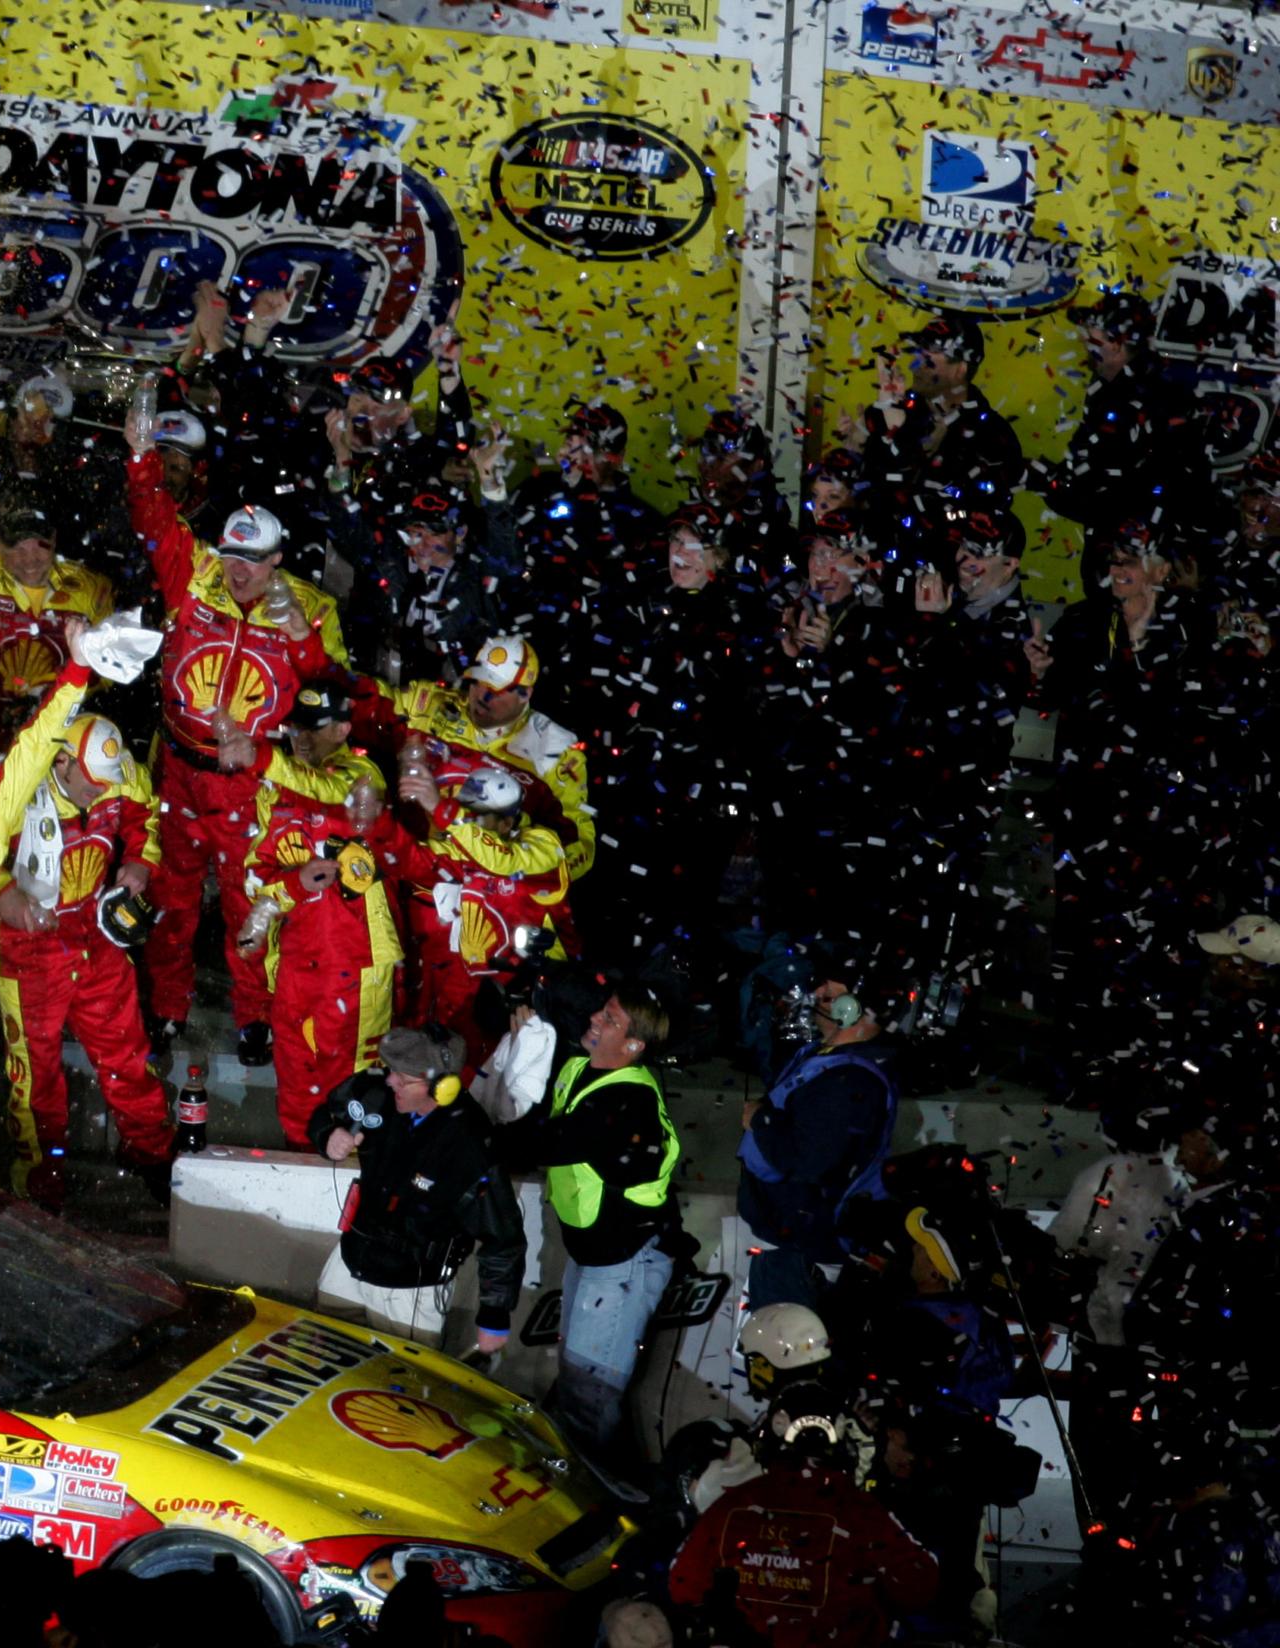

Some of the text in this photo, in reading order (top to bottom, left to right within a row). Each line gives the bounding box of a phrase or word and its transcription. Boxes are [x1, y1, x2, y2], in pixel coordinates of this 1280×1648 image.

[73, 107, 214, 137] ANNUAL
[575, 140, 666, 174] NASCAR
[534, 172, 669, 212] NEXTEL
[545, 211, 584, 231] CUP
[142, 1317, 393, 1464] PENNZOIL
[16, 1456, 42, 1468] WEAR
[49, 1443, 117, 1477] Holley
[7, 1498, 55, 1512] DIRECTV
[64, 1478, 122, 1502] Checkers
[35, 1518, 91, 1556] 3M
[154, 1498, 286, 1544] GOODYEAR
